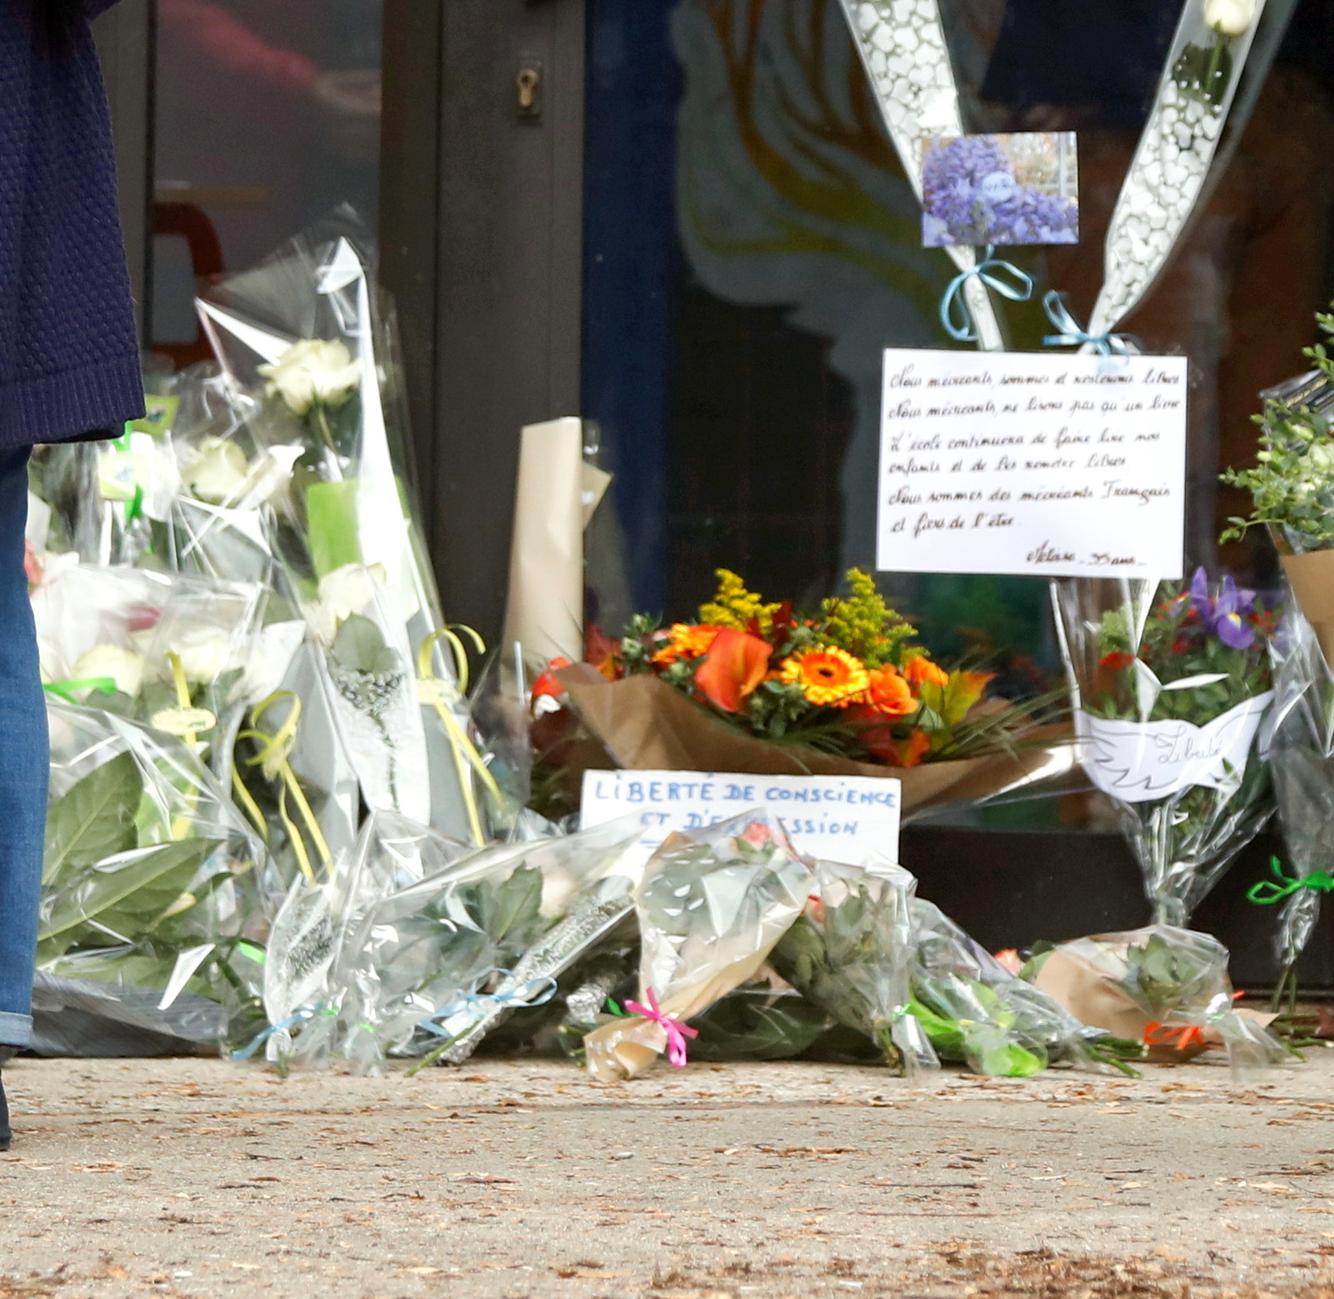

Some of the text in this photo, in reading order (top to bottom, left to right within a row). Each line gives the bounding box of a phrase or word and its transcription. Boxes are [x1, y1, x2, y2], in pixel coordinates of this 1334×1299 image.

[890, 363, 922, 388] Nous
[999, 375, 1049, 386] sommes
[1054, 372, 1067, 384] et
[888, 397, 922, 419] Nous
[1003, 404, 1018, 413] ne
[1026, 396, 1063, 411] lisons
[1069, 400, 1095, 417] pas
[948, 434, 1024, 450] continuera
[1031, 433, 1047, 444] de
[1055, 426, 1091, 449] faire
[1097, 427, 1125, 443] lire
[1135, 433, 1160, 442] nos
[889, 458, 940, 478] enfants
[950, 459, 963, 472] et
[971, 459, 987, 471] de
[995, 454, 1017, 471] les
[1025, 457, 1075, 470] rendre
[888, 485, 922, 505] Nous
[928, 490, 982, 502] sommes
[988, 487, 1010, 501] des
[1100, 479, 1170, 506] Français
[890, 518, 906, 533] et
[947, 516, 965, 529] de
[1154, 724, 1223, 764] Liberté
[722, 784, 754, 801] DE
